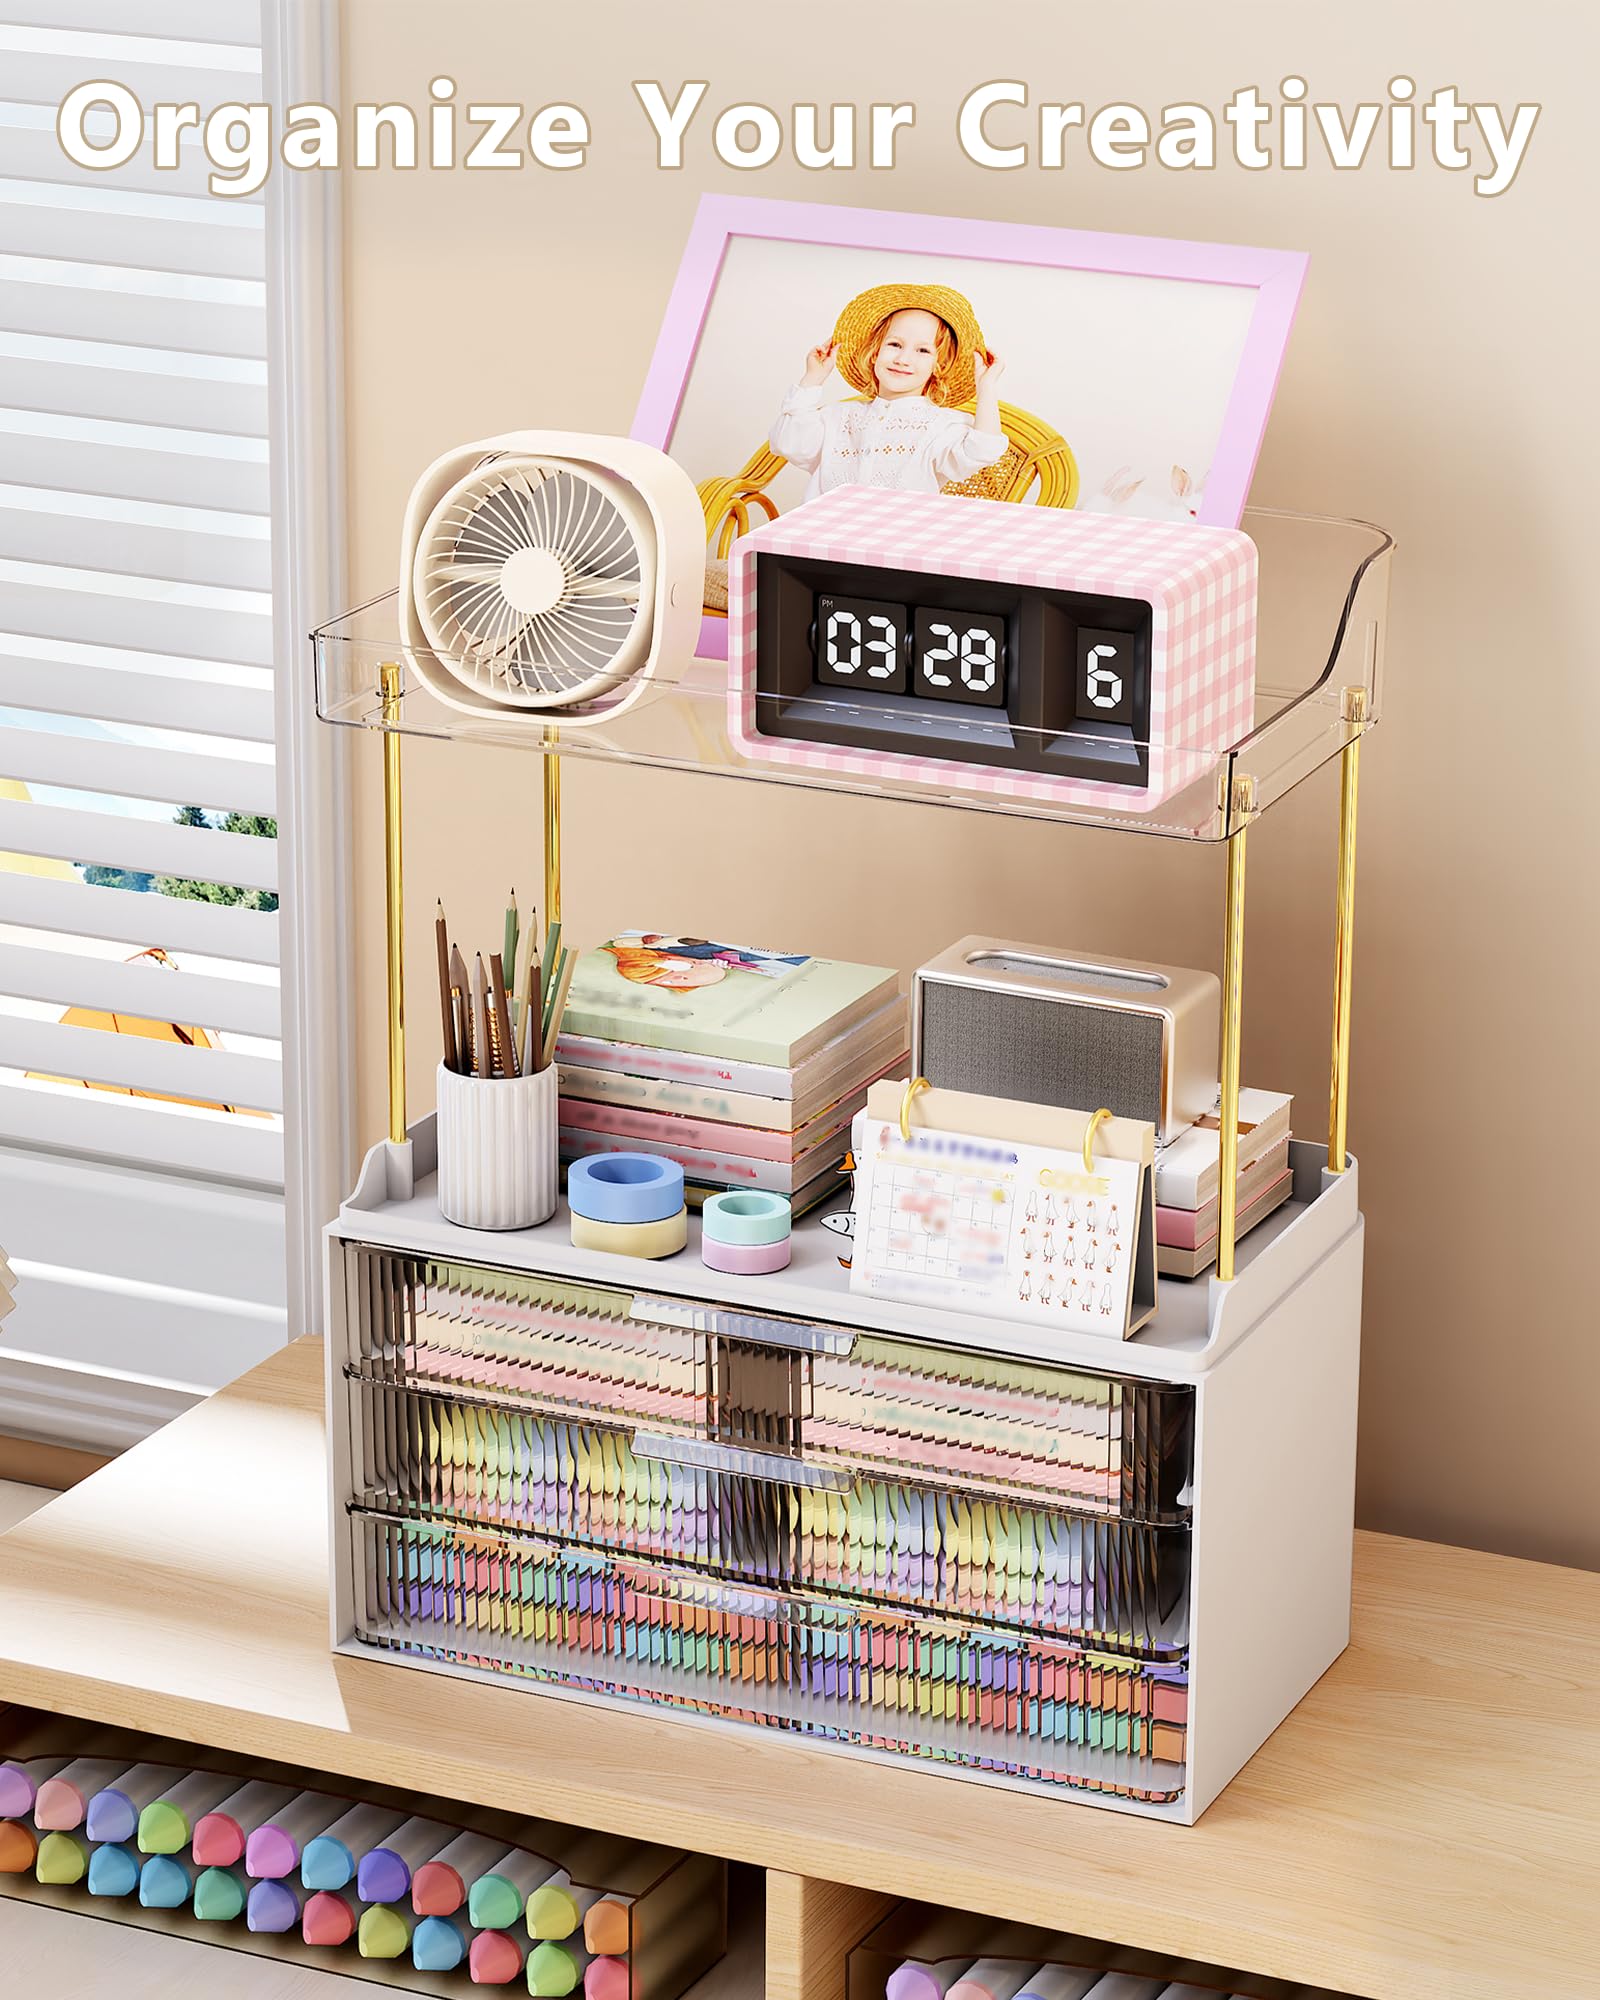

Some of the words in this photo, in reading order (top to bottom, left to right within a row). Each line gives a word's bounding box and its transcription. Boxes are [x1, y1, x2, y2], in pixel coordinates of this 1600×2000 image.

[821, 599, 834, 608] PM
[827, 610, 897, 679] 03
[923, 623, 996, 692] 28
[1086, 644, 1123, 709] 6
